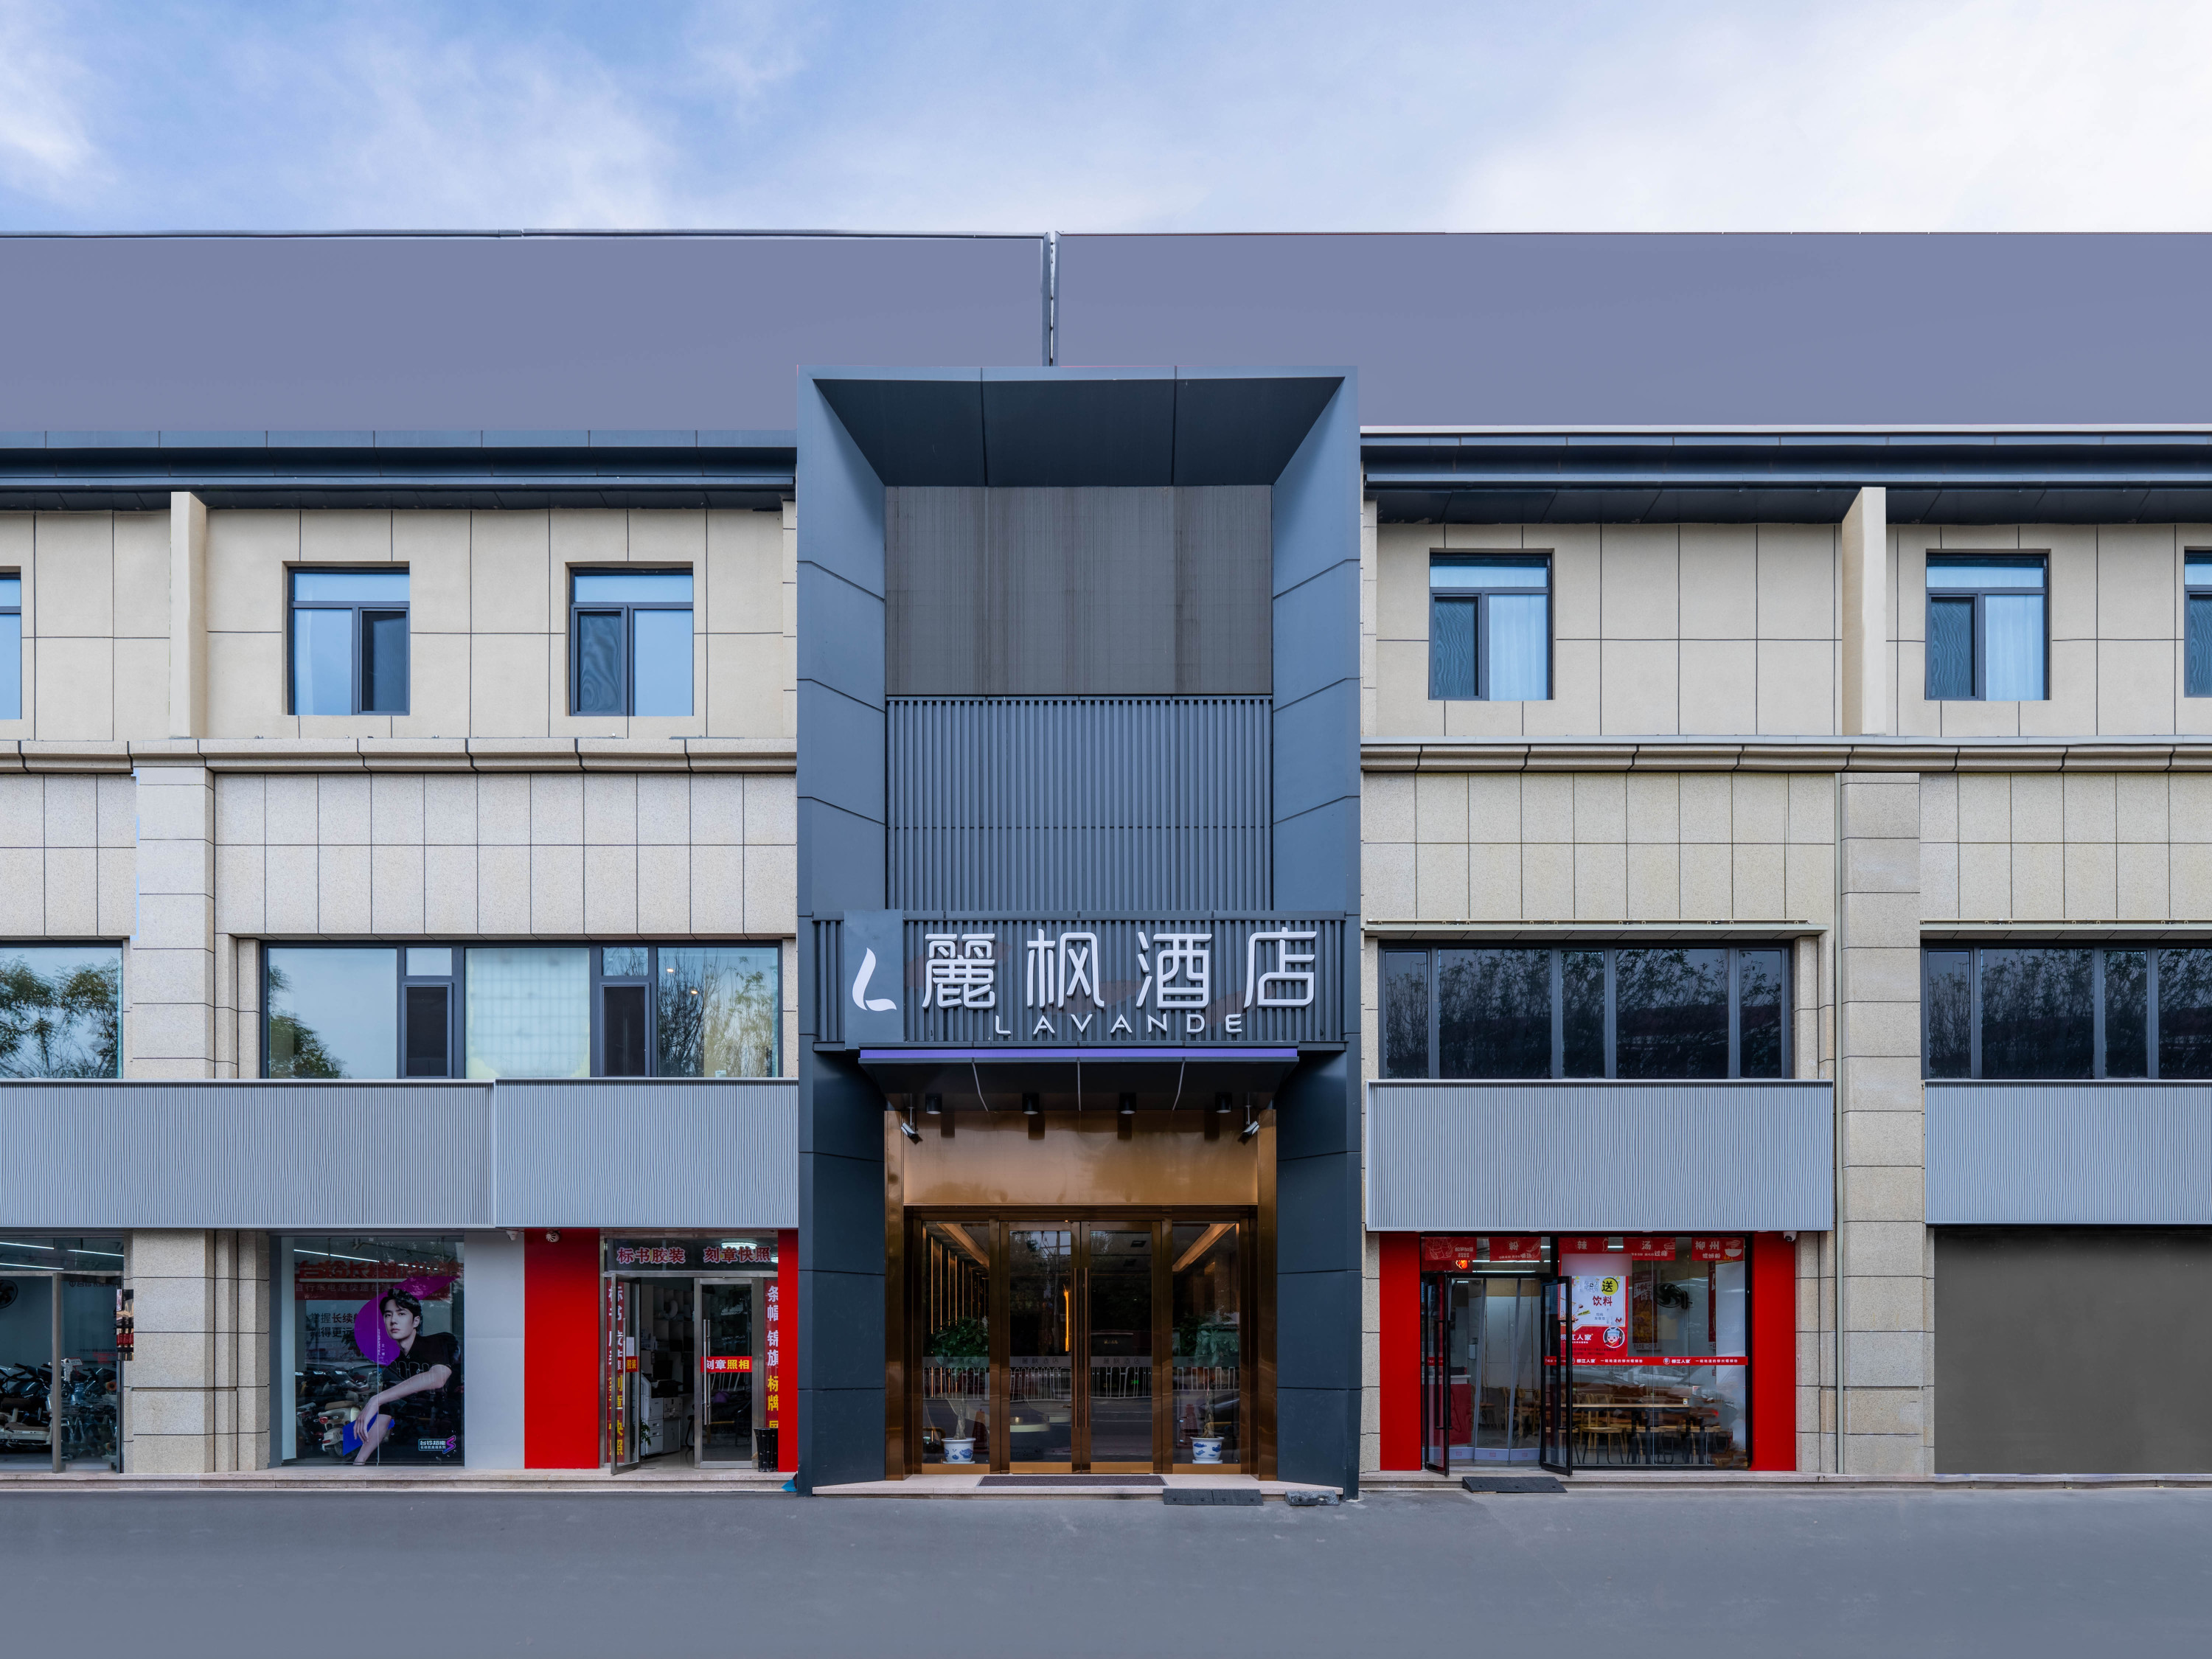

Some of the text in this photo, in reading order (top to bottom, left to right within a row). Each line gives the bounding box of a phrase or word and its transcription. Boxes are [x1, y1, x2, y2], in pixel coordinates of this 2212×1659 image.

[995, 1013, 1242, 1035] LAVANDE
[616, 1246, 771, 1264] 标书胶装 刻章快照
[1601, 1281, 1613, 1292] 送
[1593, 1295, 1613, 1307] 饮料
[706, 1359, 750, 1370] 刻章照相
